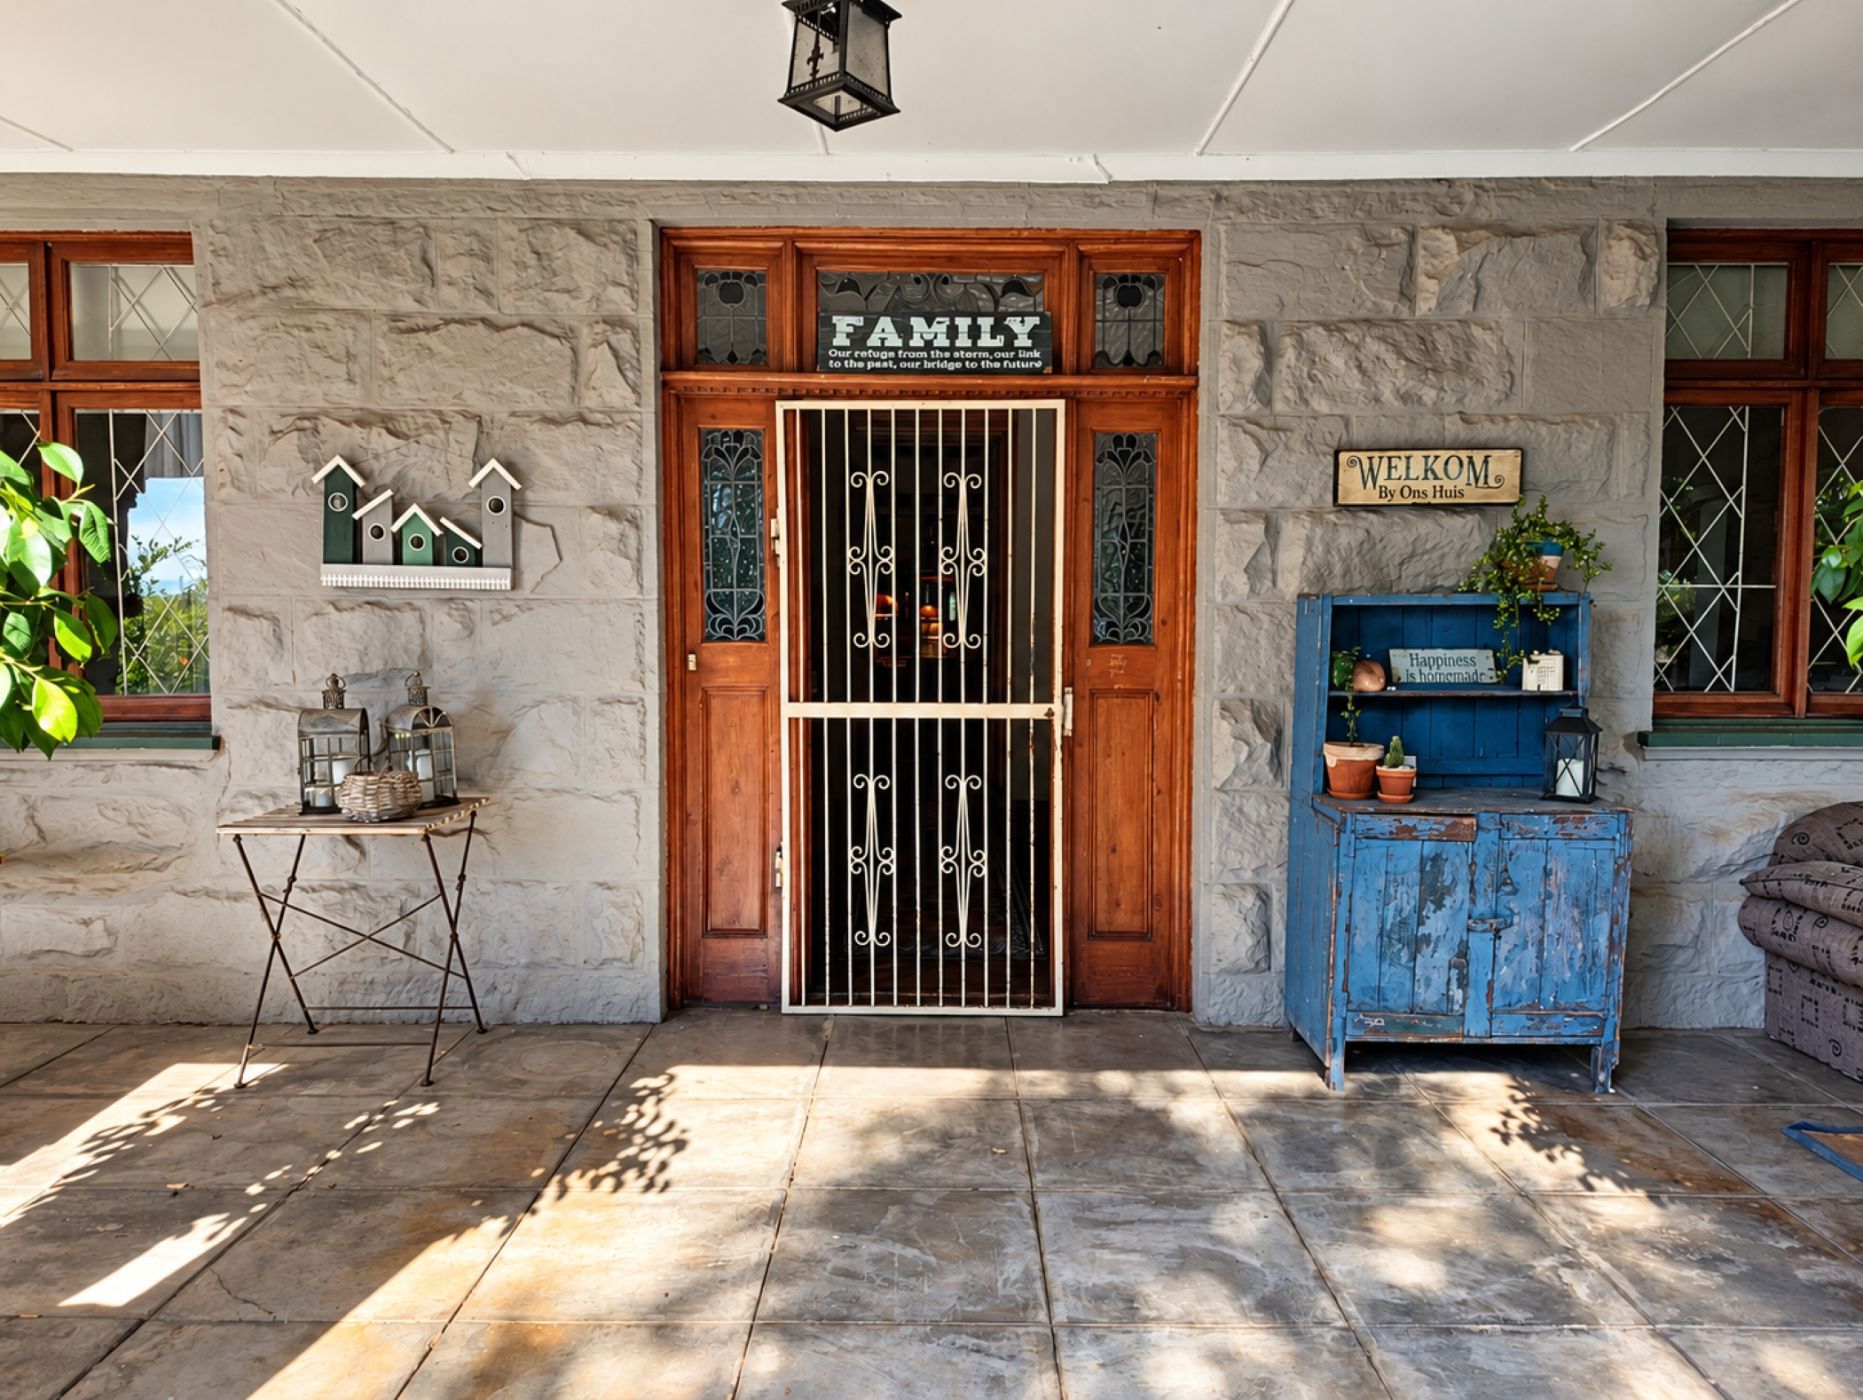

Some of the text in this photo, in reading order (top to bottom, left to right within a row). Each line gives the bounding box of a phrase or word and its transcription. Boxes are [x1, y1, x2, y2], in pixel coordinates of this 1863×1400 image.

[832, 315, 1041, 347] FAMILY
[828, 349, 852, 358] Our
[898, 349, 928, 358] from
[930, 349, 951, 358] the
[1018, 349, 1041, 358] link
[828, 359, 841, 368] to
[844, 359, 864, 368] the
[900, 361, 920, 369] our
[923, 359, 962, 370] bridge
[965, 360, 978, 369] to
[981, 359, 1001, 368] the
[1003, 359, 1043, 368] future
[1347, 455, 1505, 490] WELKOM
[1378, 485, 1465, 502] By Ons Huis
[1409, 653, 1477, 670] Happiness
[1405, 669, 1486, 683] is homemade
